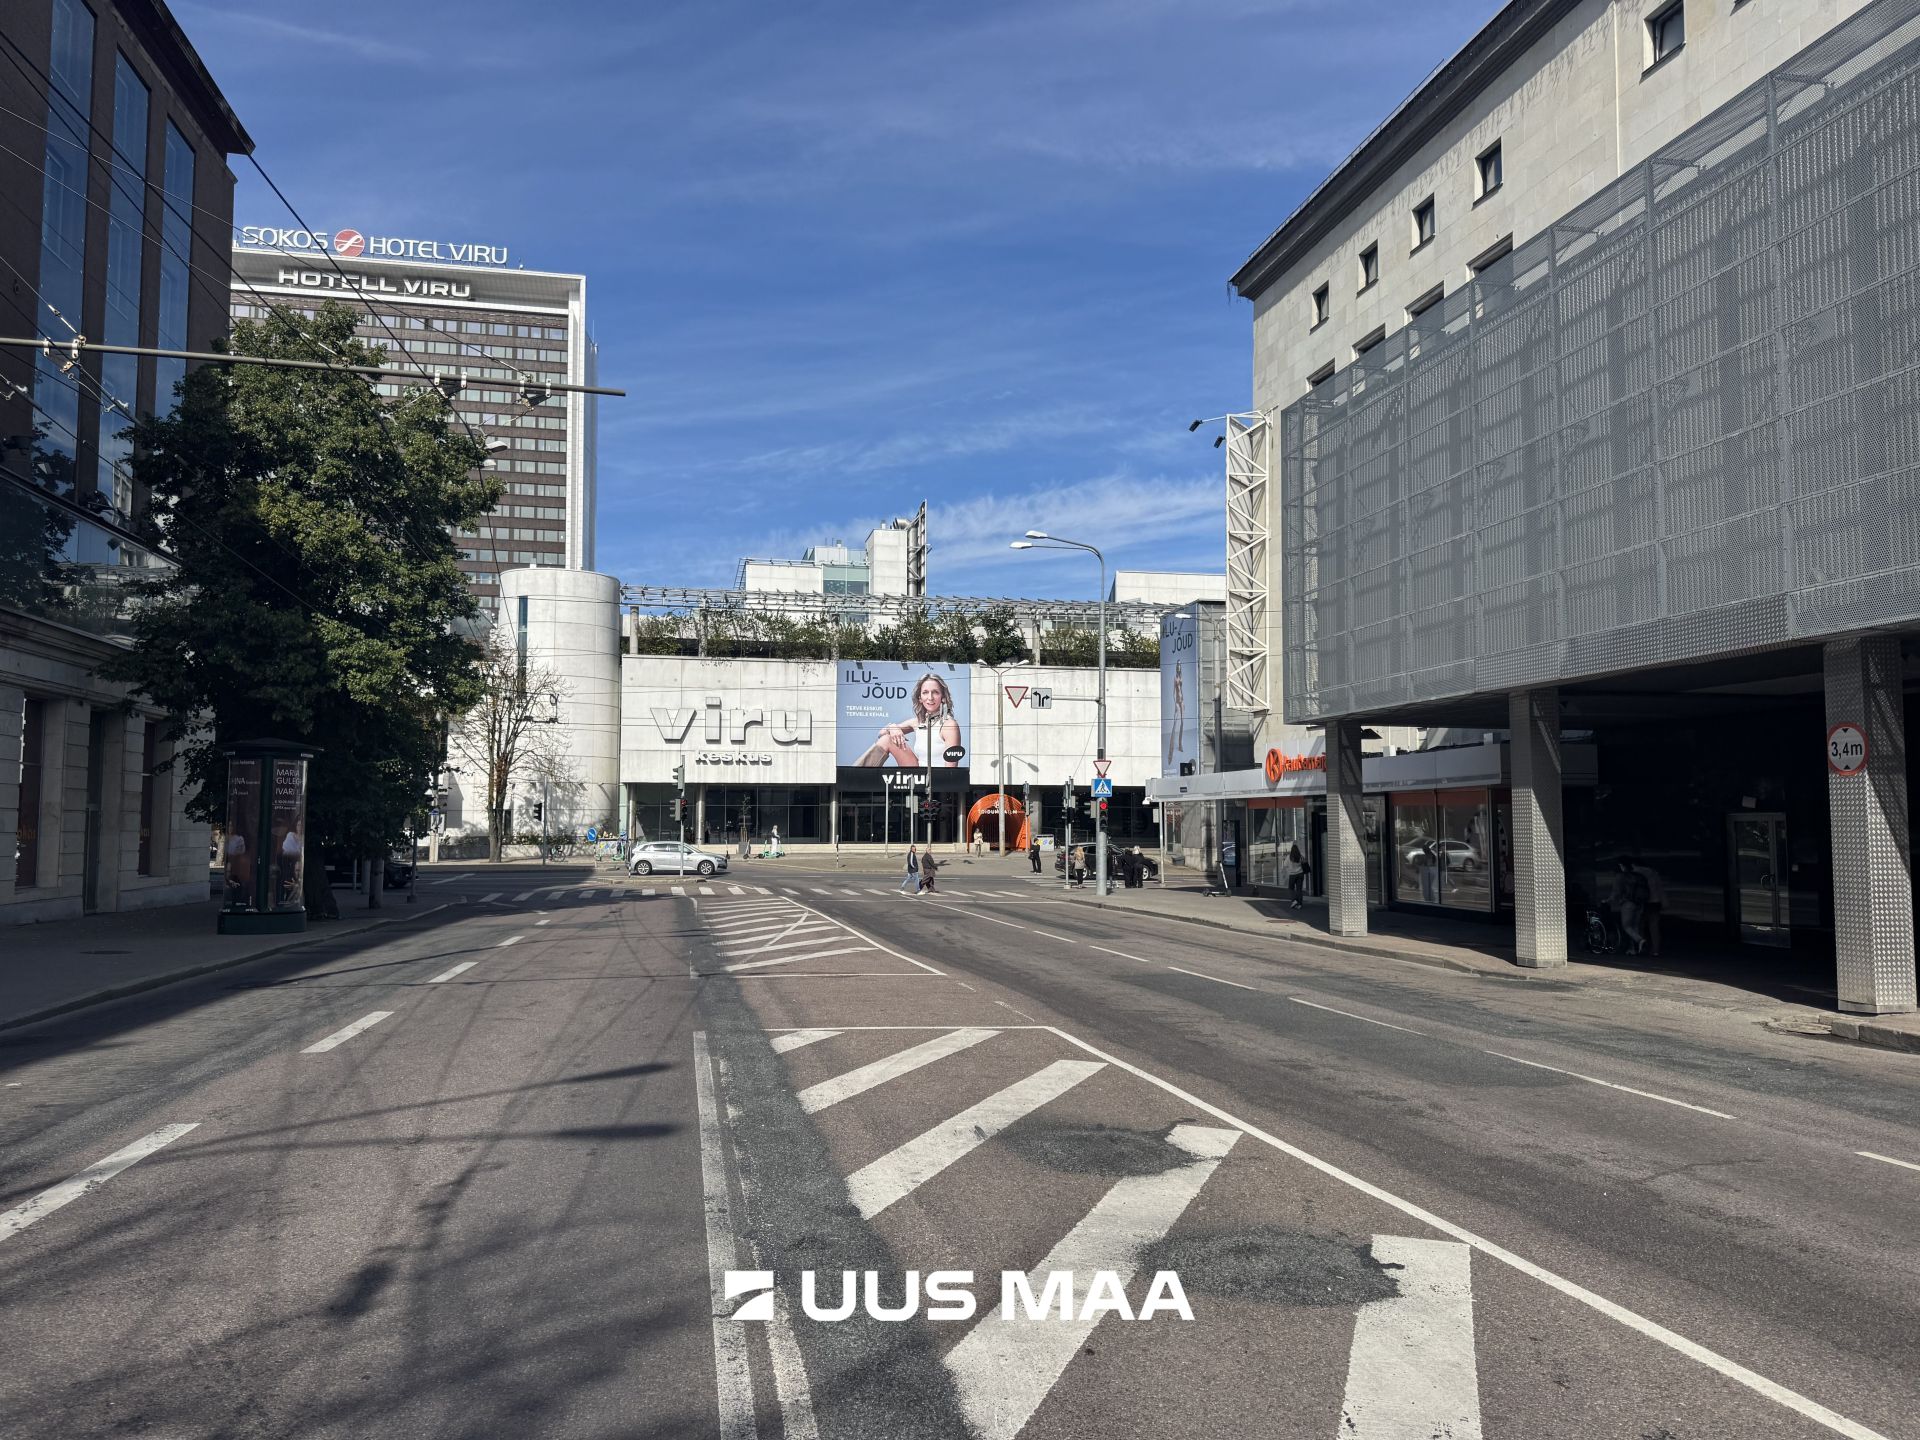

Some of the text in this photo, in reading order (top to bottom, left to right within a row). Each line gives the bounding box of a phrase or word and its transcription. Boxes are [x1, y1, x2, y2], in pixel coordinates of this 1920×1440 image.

[242, 226, 508, 265] SOKOS HOTEL VIRU
[278, 268, 471, 299] HOTELL VIRU
[846, 670, 879, 684] ILU-
[862, 683, 908, 699] JÕUD
[650, 697, 812, 743] viru
[695, 750, 773, 765] keskus
[946, 749, 963, 757] viru
[881, 771, 925, 784] viru
